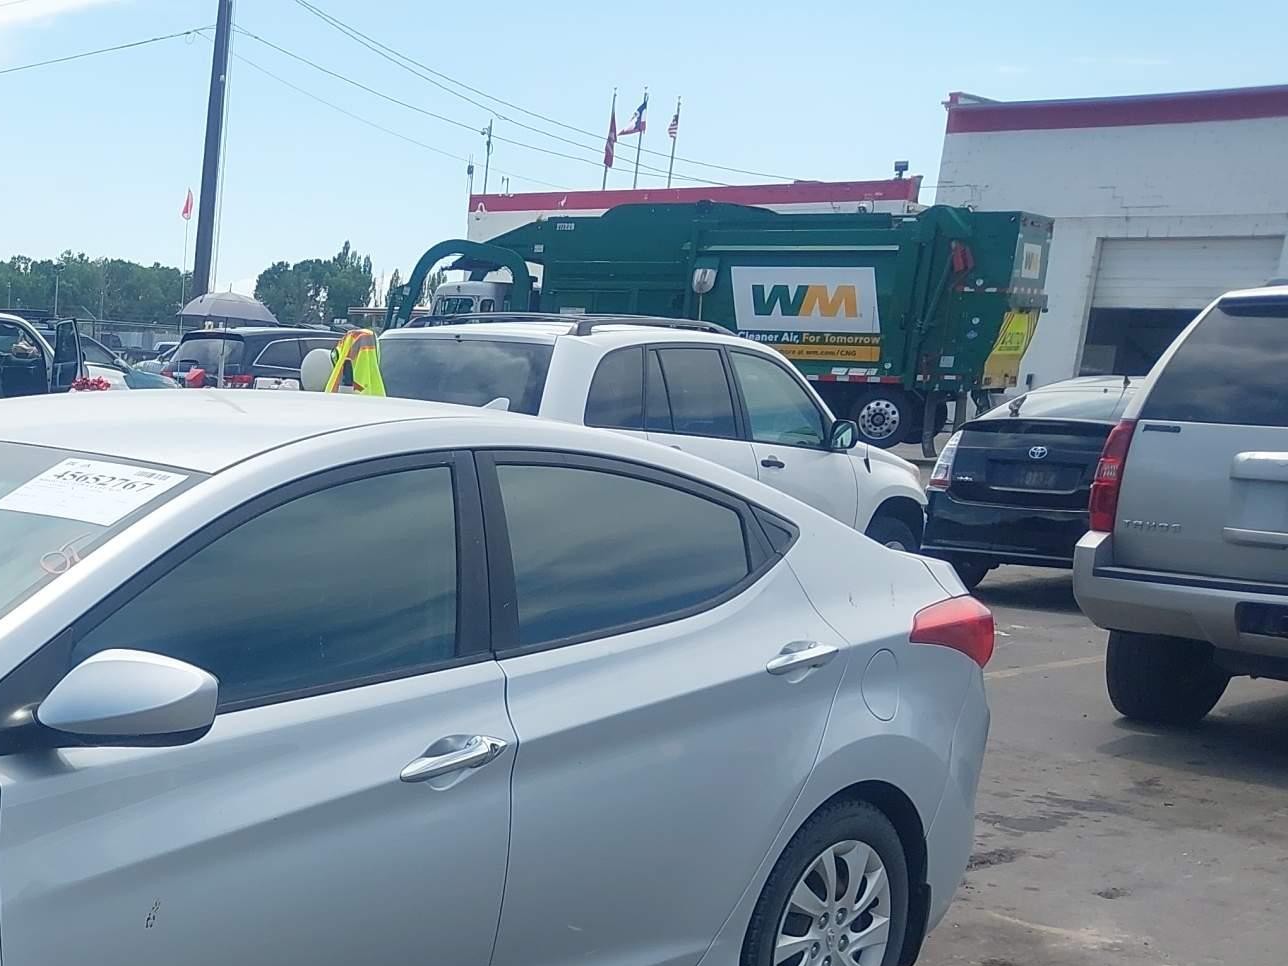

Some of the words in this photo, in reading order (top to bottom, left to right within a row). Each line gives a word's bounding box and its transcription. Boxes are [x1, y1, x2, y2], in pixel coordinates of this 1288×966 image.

[752, 284, 858, 318] WM
[738, 331, 779, 342] Cleaner
[781, 332, 799, 343] Air,
[803, 333, 820, 343] For
[824, 333, 880, 344] Tomorrow
[54, 470, 155, 492] 45652767
